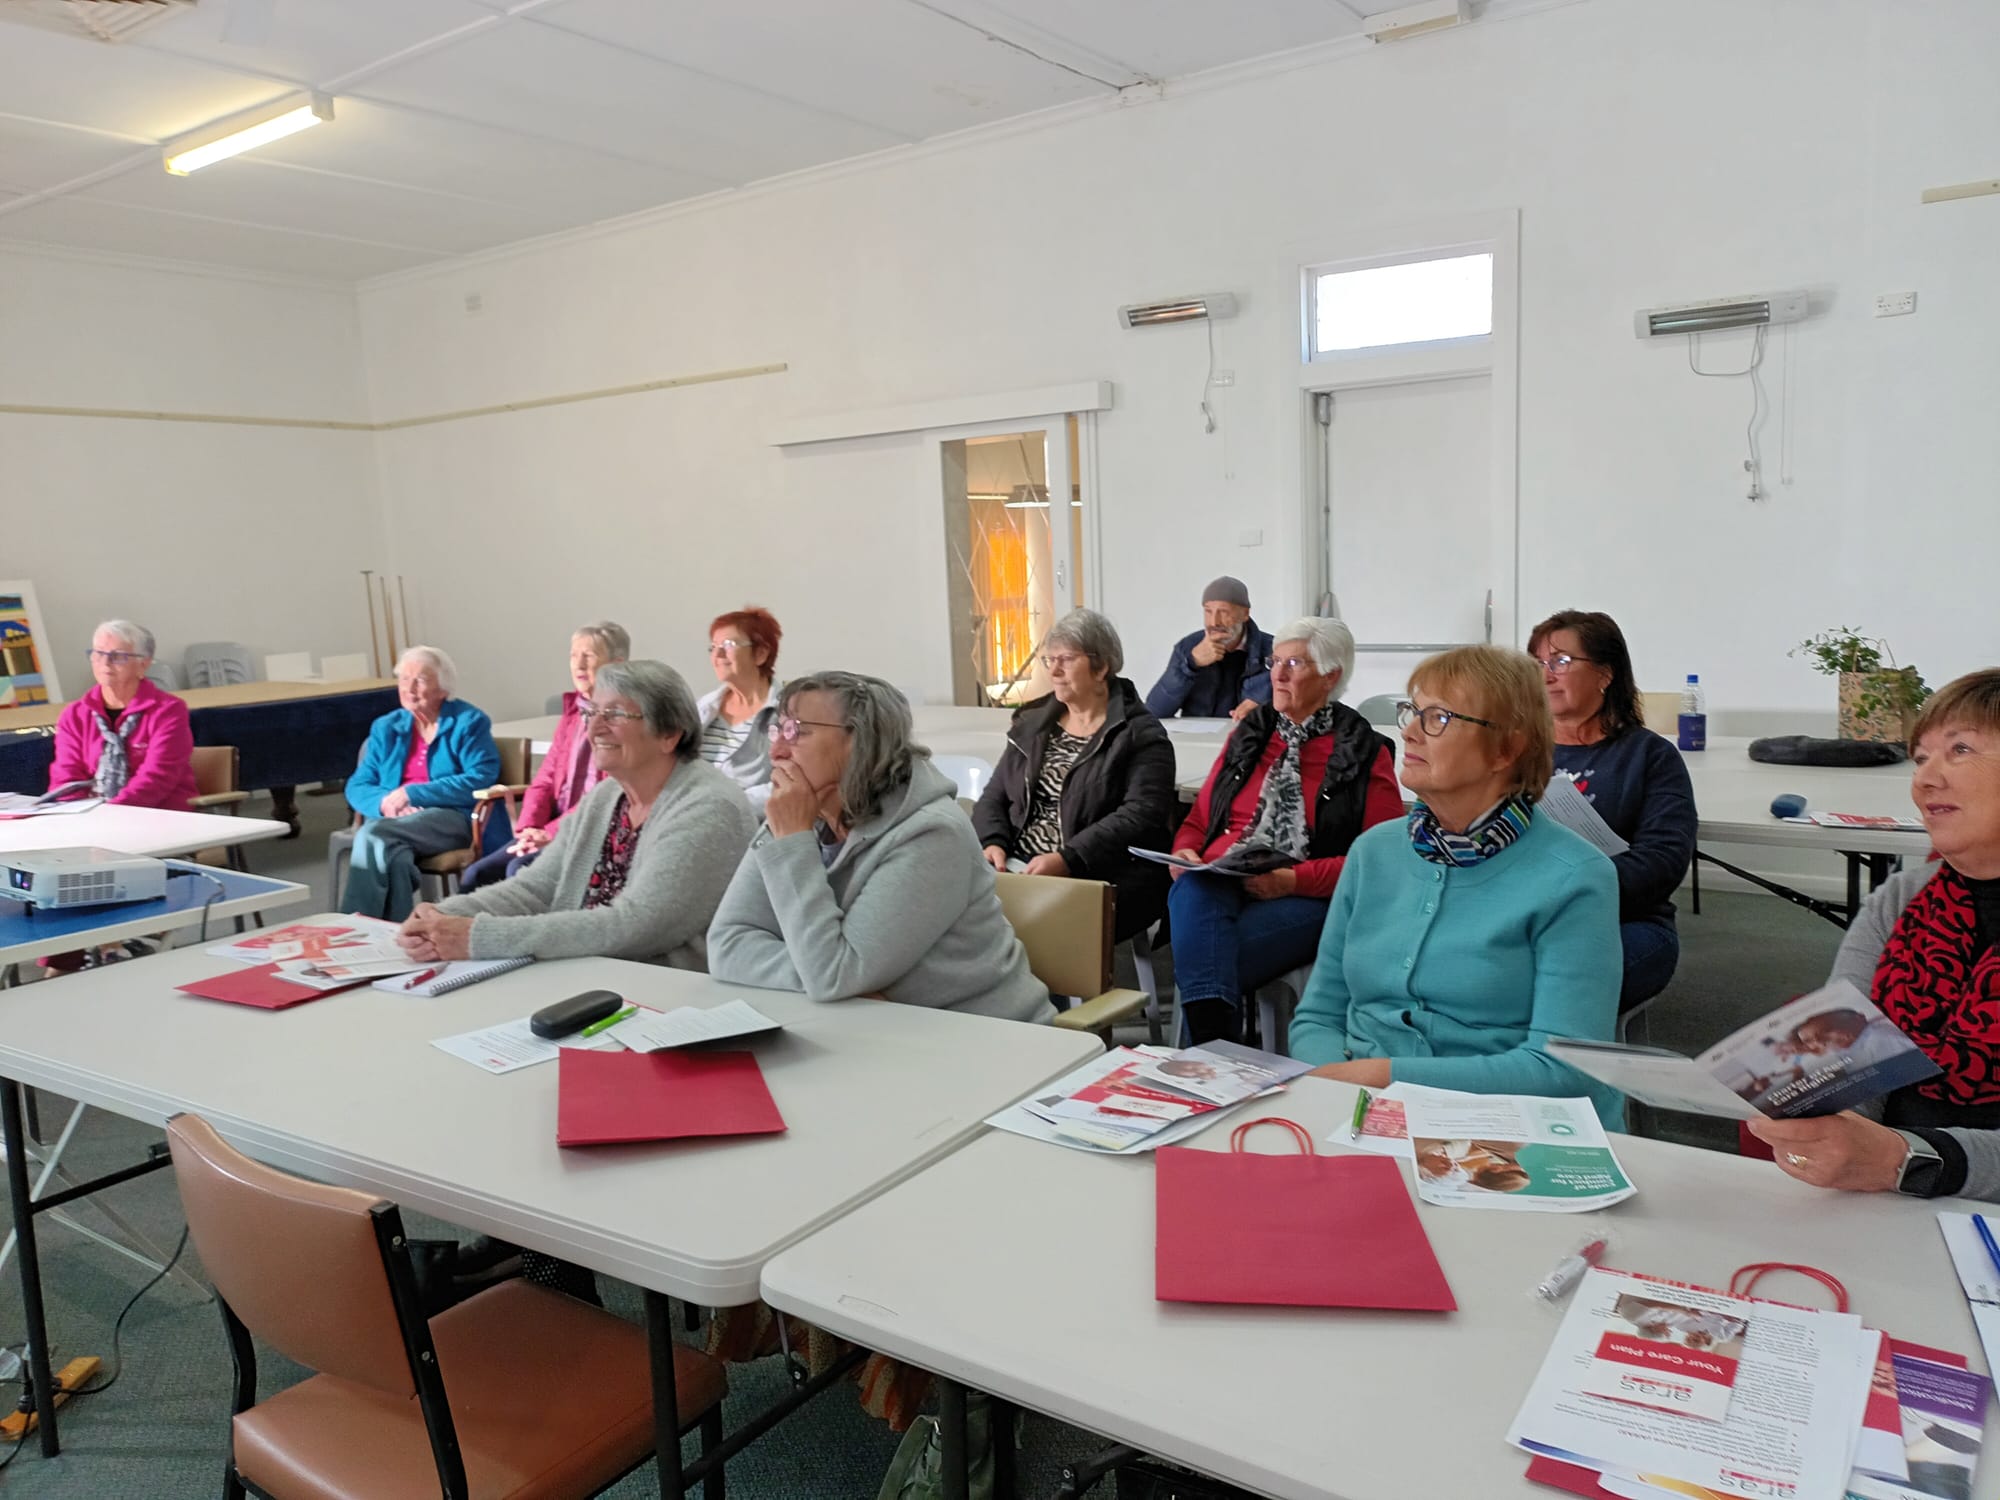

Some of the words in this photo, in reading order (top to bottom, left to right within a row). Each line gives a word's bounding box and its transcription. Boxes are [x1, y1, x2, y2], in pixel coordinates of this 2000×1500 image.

[1609, 1343, 1645, 1357] Plan
[1647, 1351, 1685, 1365] Care
[1686, 1359, 1724, 1376] Your
[1620, 1380, 1693, 1402] aras
[1718, 1474, 1797, 1499] aras
